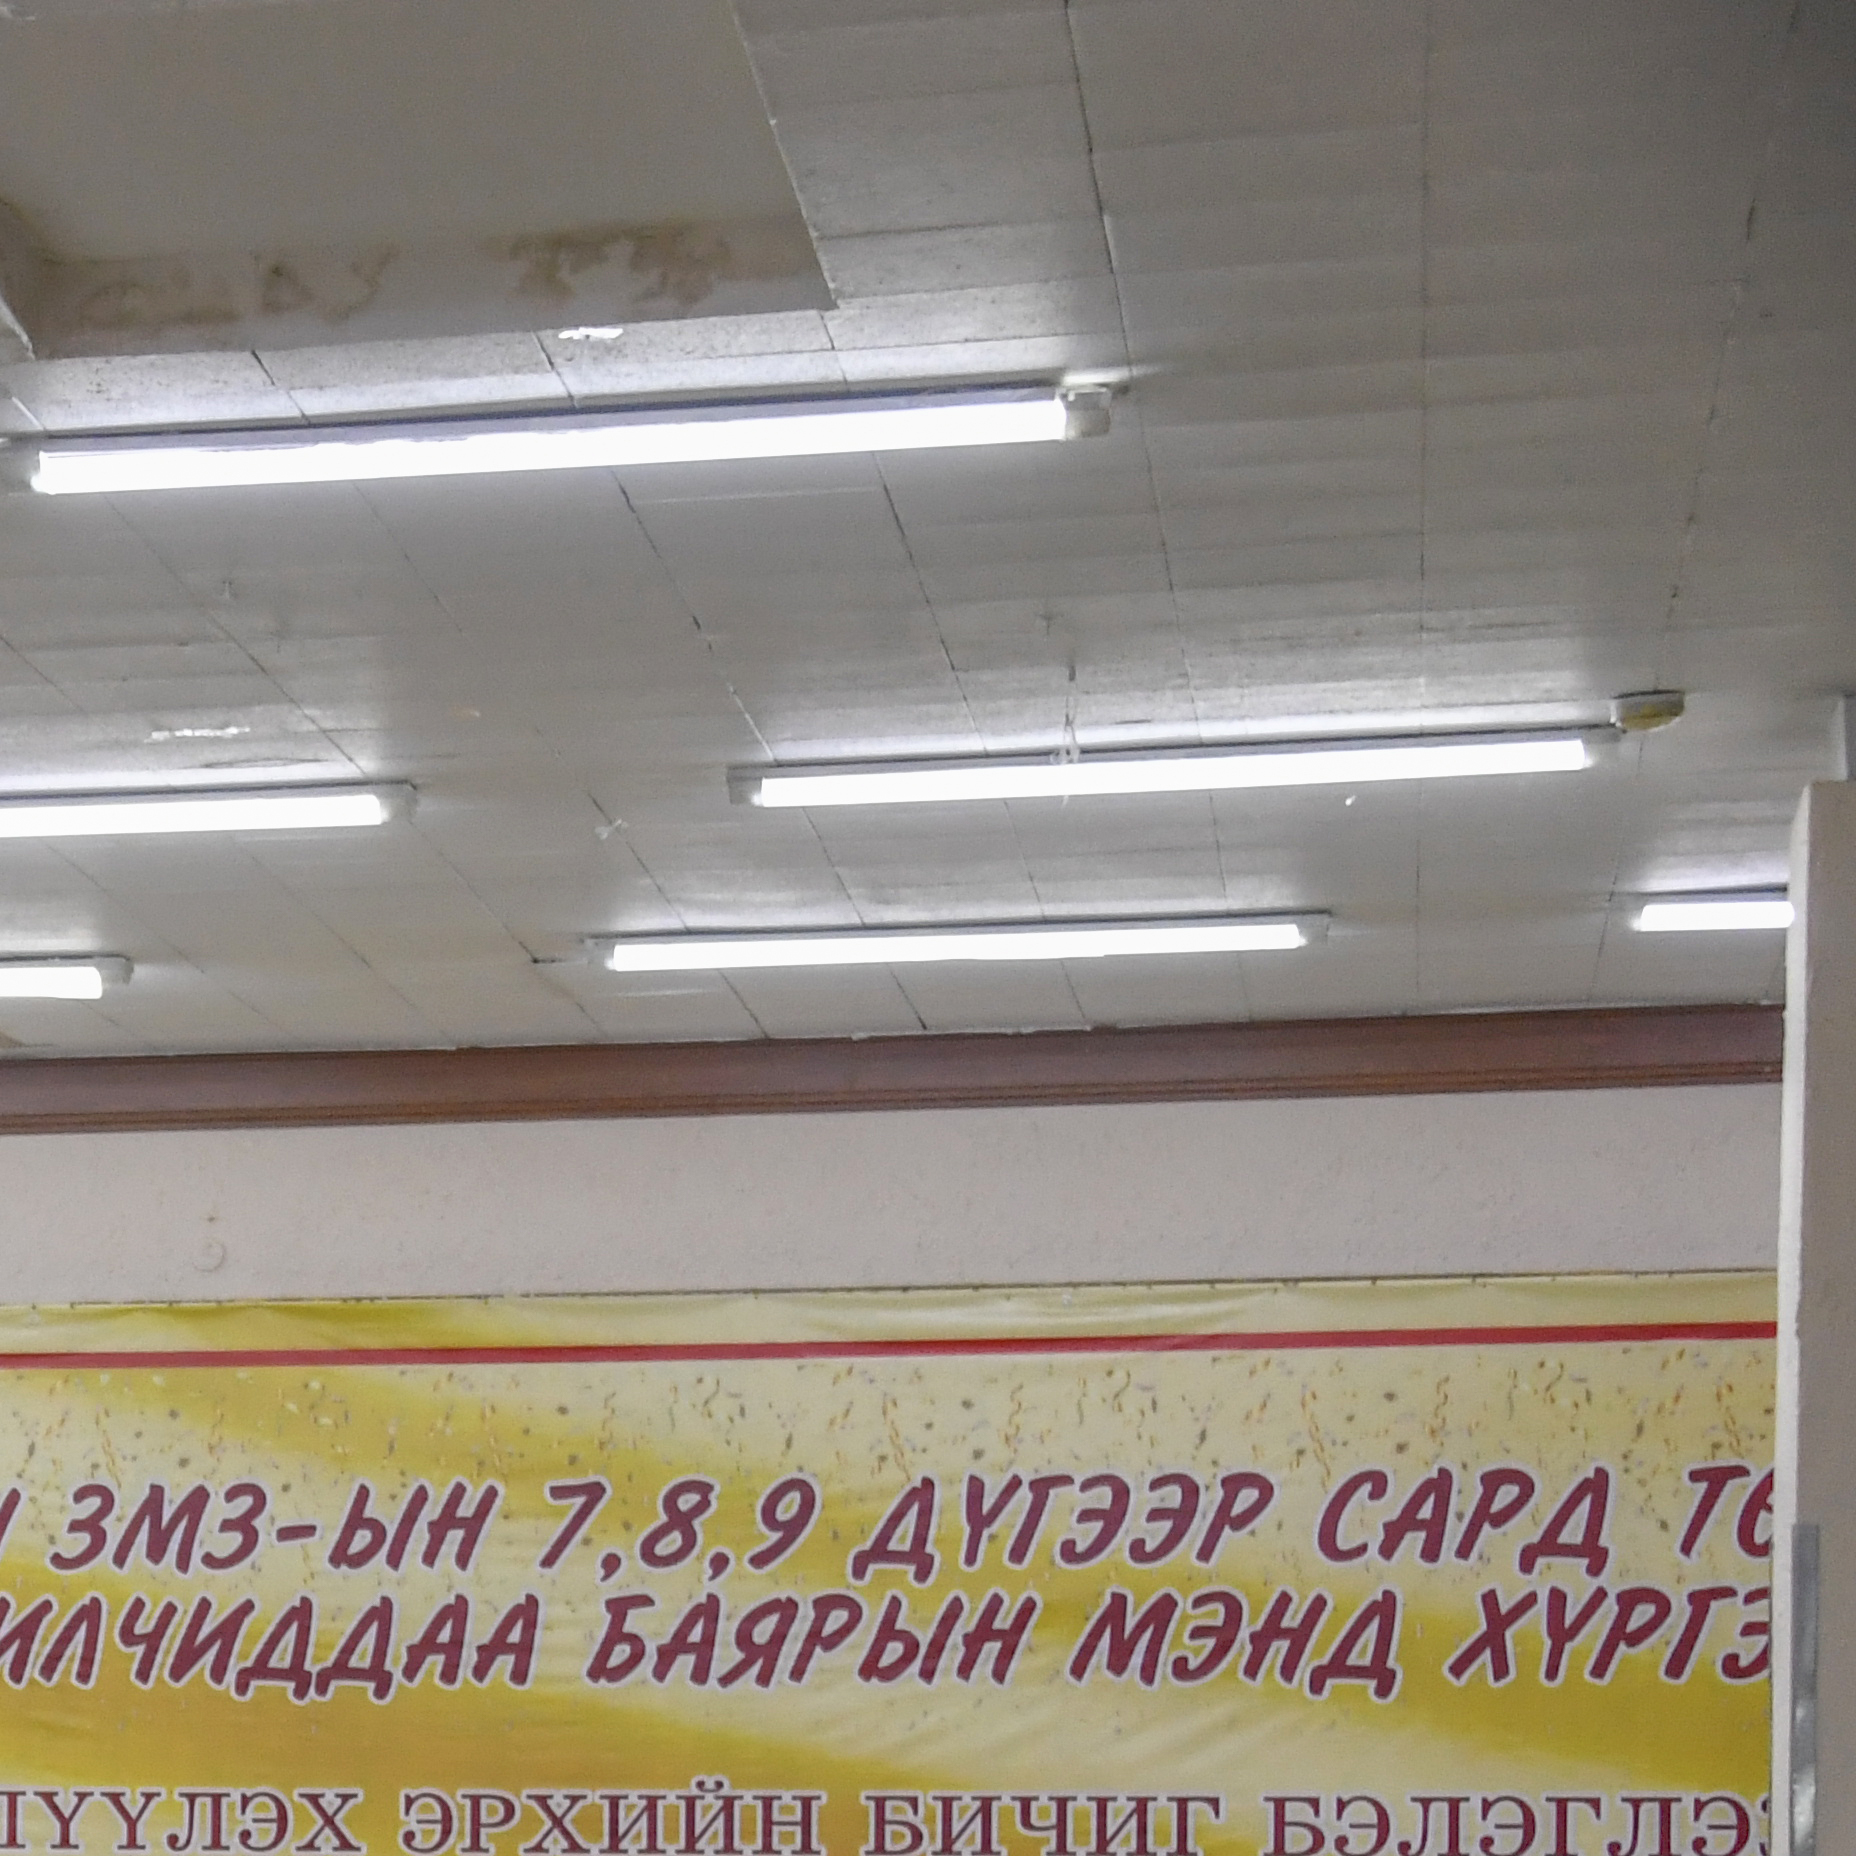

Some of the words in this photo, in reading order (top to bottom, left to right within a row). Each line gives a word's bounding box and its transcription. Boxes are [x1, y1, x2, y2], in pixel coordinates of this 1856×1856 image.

[50, 1484, 498, 1572] ЗМЗ-ЫН
[543, 1484, 814, 1575] 7,8,9
[853, 1473, 1274, 1581] ДҮГЭЭР
[1318, 1467, 1609, 1577] САРД
[589, 1594, 1037, 1686] БАЯРЫН
[1071, 1590, 1397, 1698] МЭНД
[401, 1779, 823, 1856] ЭРХИЙН
